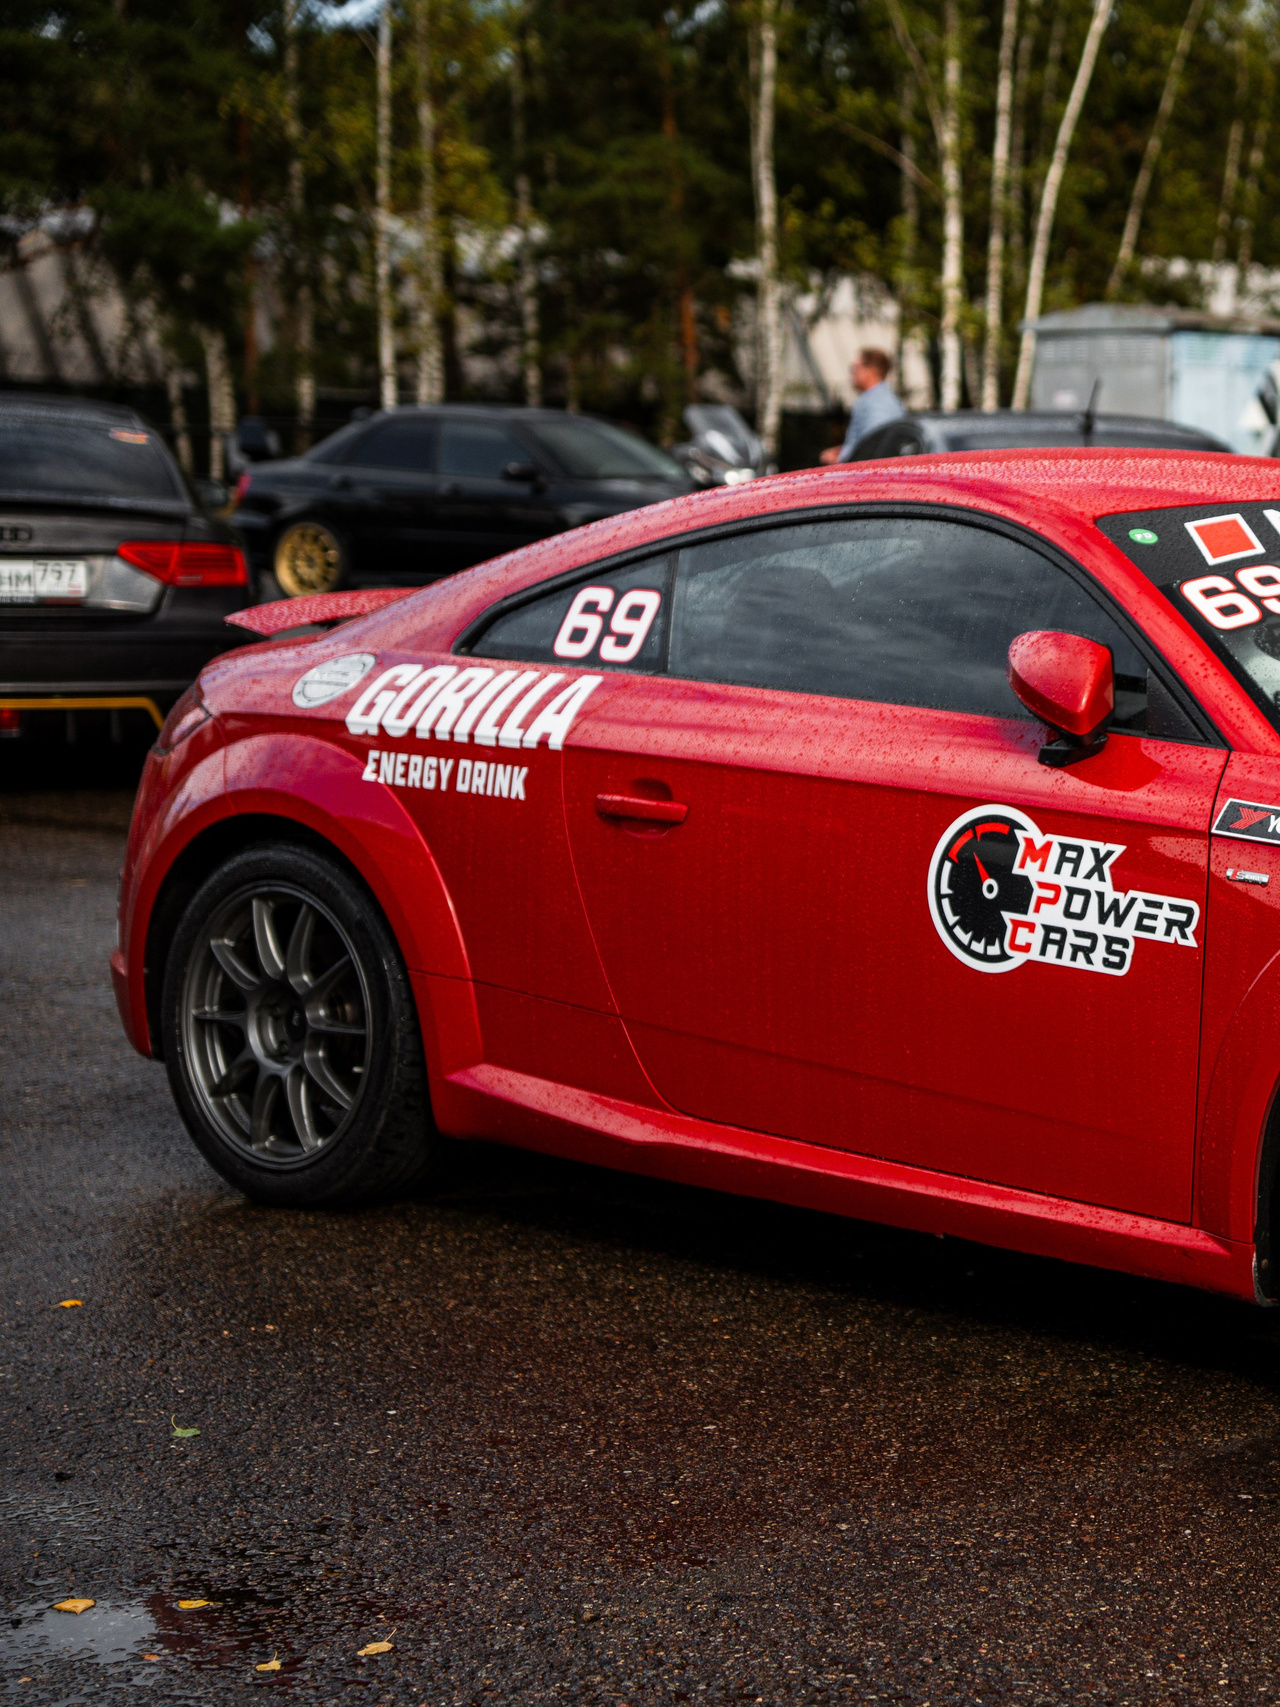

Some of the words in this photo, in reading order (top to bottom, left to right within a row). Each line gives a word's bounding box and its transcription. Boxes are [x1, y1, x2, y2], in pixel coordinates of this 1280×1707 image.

[554, 587, 661, 663] 69
[345, 663, 603, 750] GORILLA
[362, 750, 453, 791] ENERGY
[456, 759, 528, 800] DRINK
[1018, 837, 1116, 882] MAX
[1033, 881, 1195, 940] POWER
[1008, 918, 1130, 971] CARS
